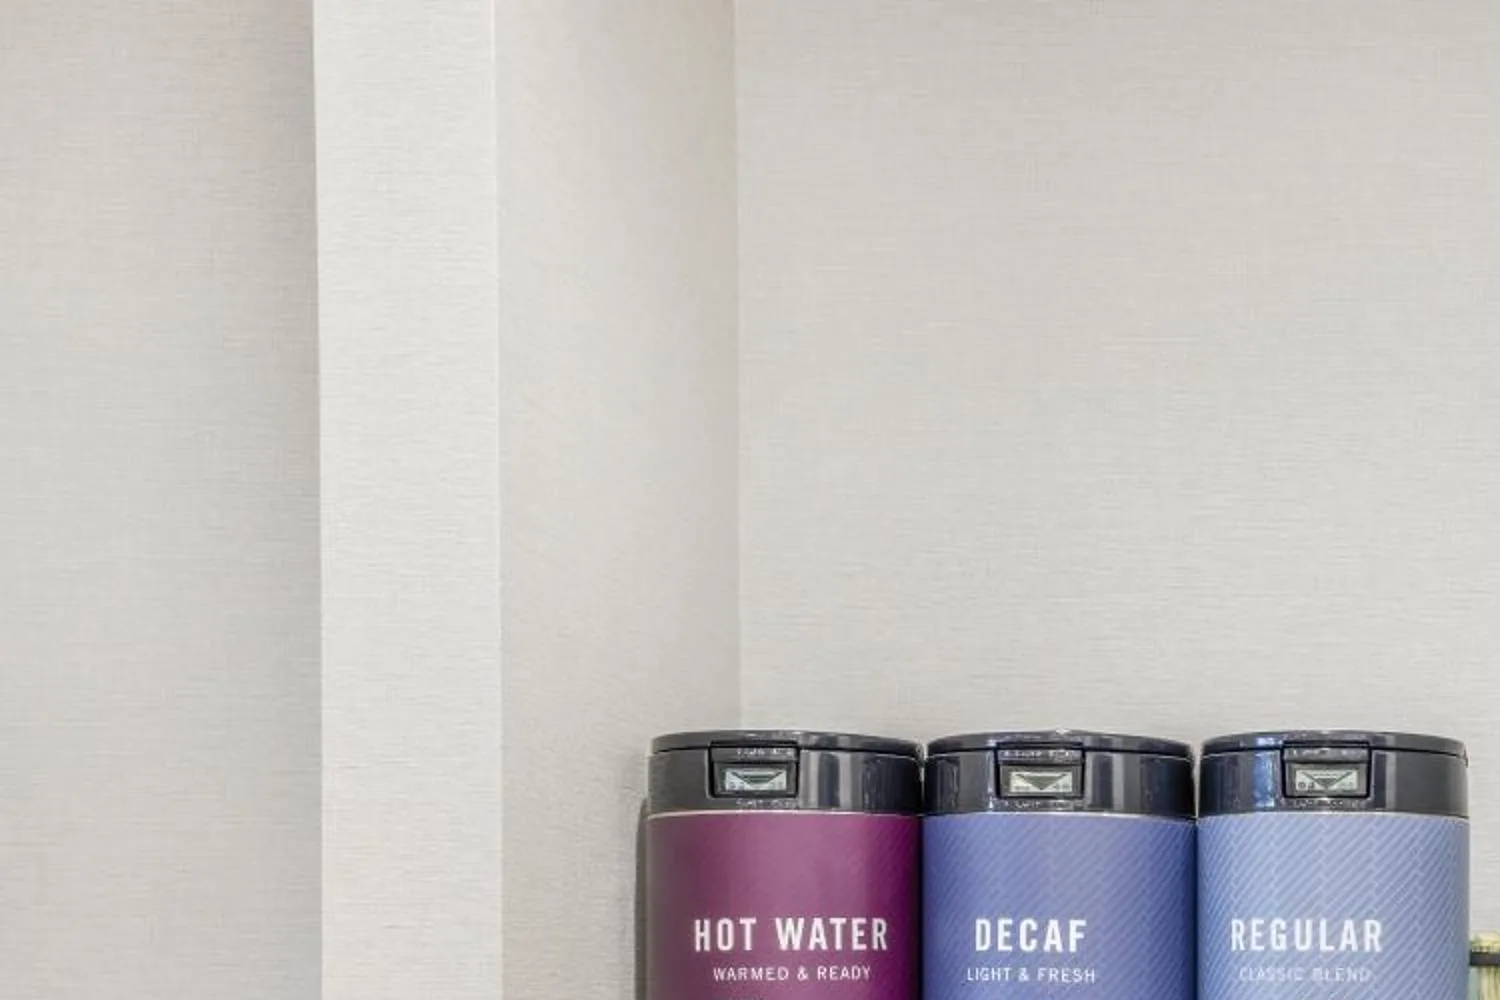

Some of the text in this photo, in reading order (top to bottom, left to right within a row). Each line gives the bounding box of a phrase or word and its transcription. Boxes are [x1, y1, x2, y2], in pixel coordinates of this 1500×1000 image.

[694, 917, 888, 952] HOT WATER
[975, 918, 1087, 952] DECAF
[1231, 918, 1383, 951] REGULAR
[713, 965, 872, 981] WARMED & READY
[967, 967, 1096, 983] LIGHT & FRESH
[1239, 967, 1372, 982] CLASSIC BLEND
